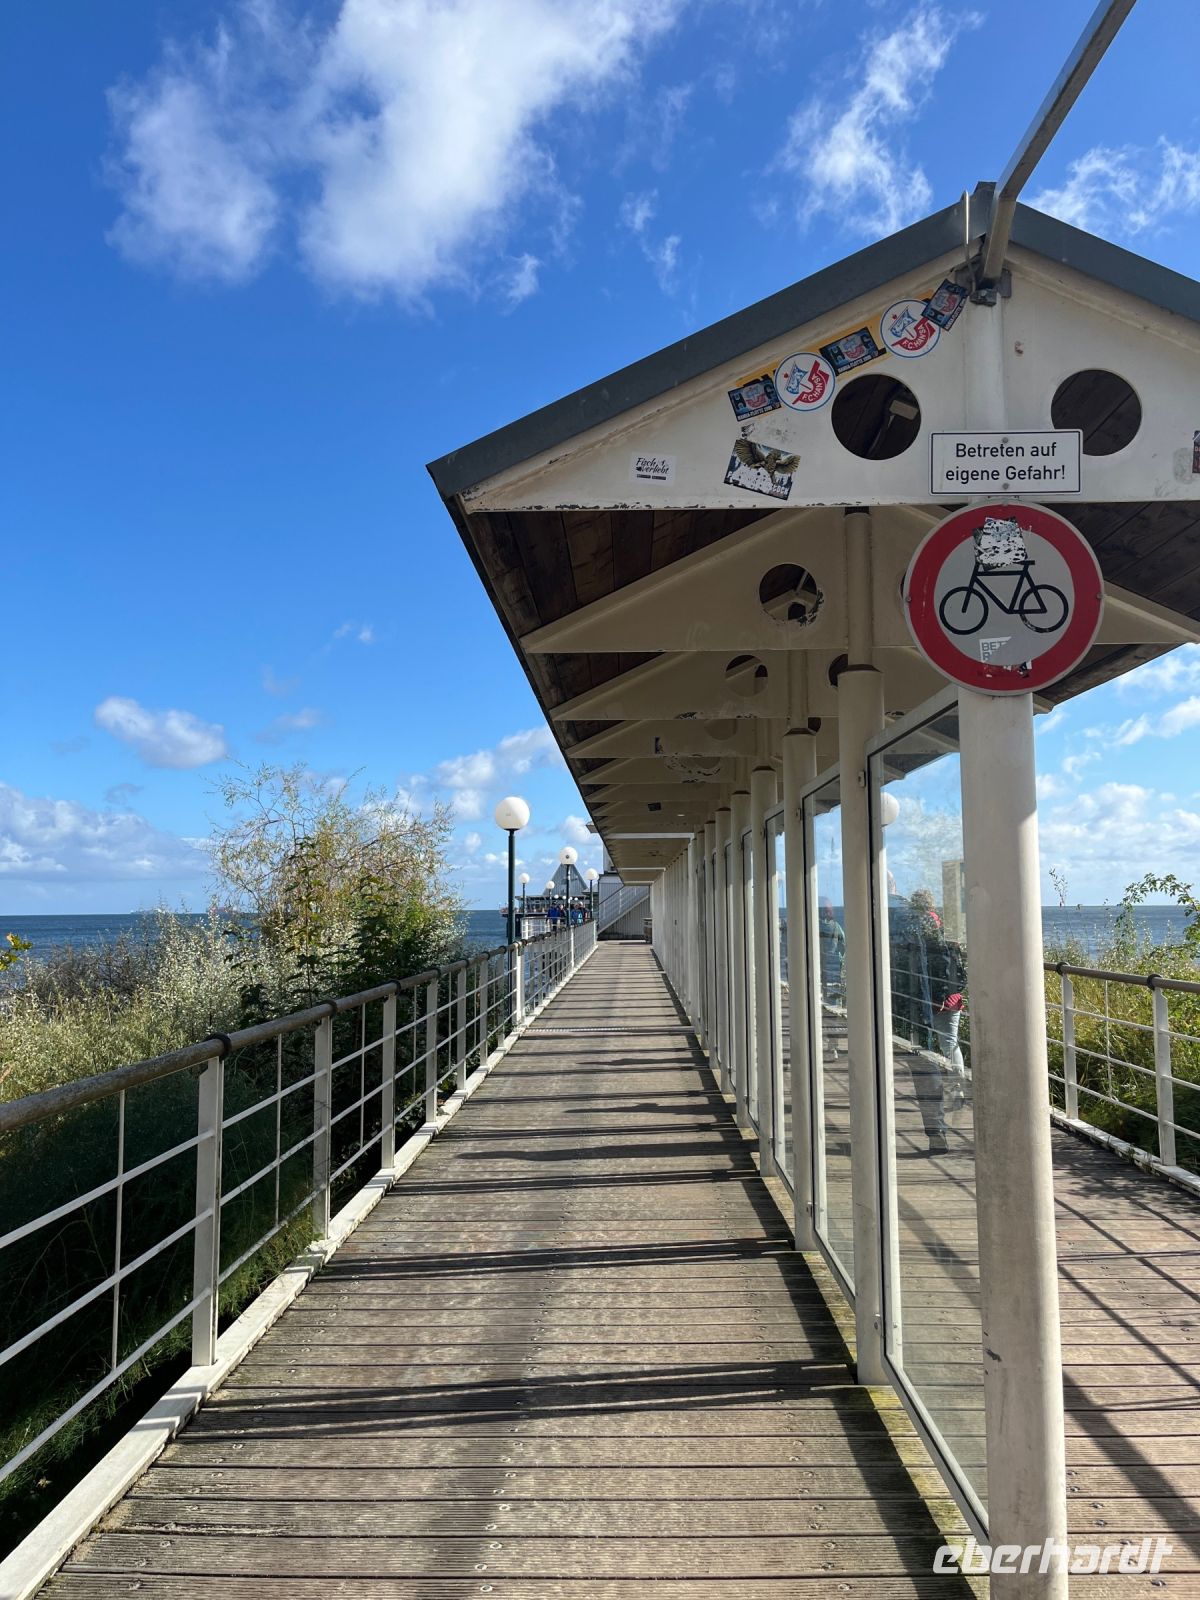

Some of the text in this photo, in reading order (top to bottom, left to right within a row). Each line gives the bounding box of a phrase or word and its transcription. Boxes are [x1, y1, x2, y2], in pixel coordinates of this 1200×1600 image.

[955, 442, 1057, 458] Betreten auf
[945, 465, 1065, 485] eigene Gefahr!
